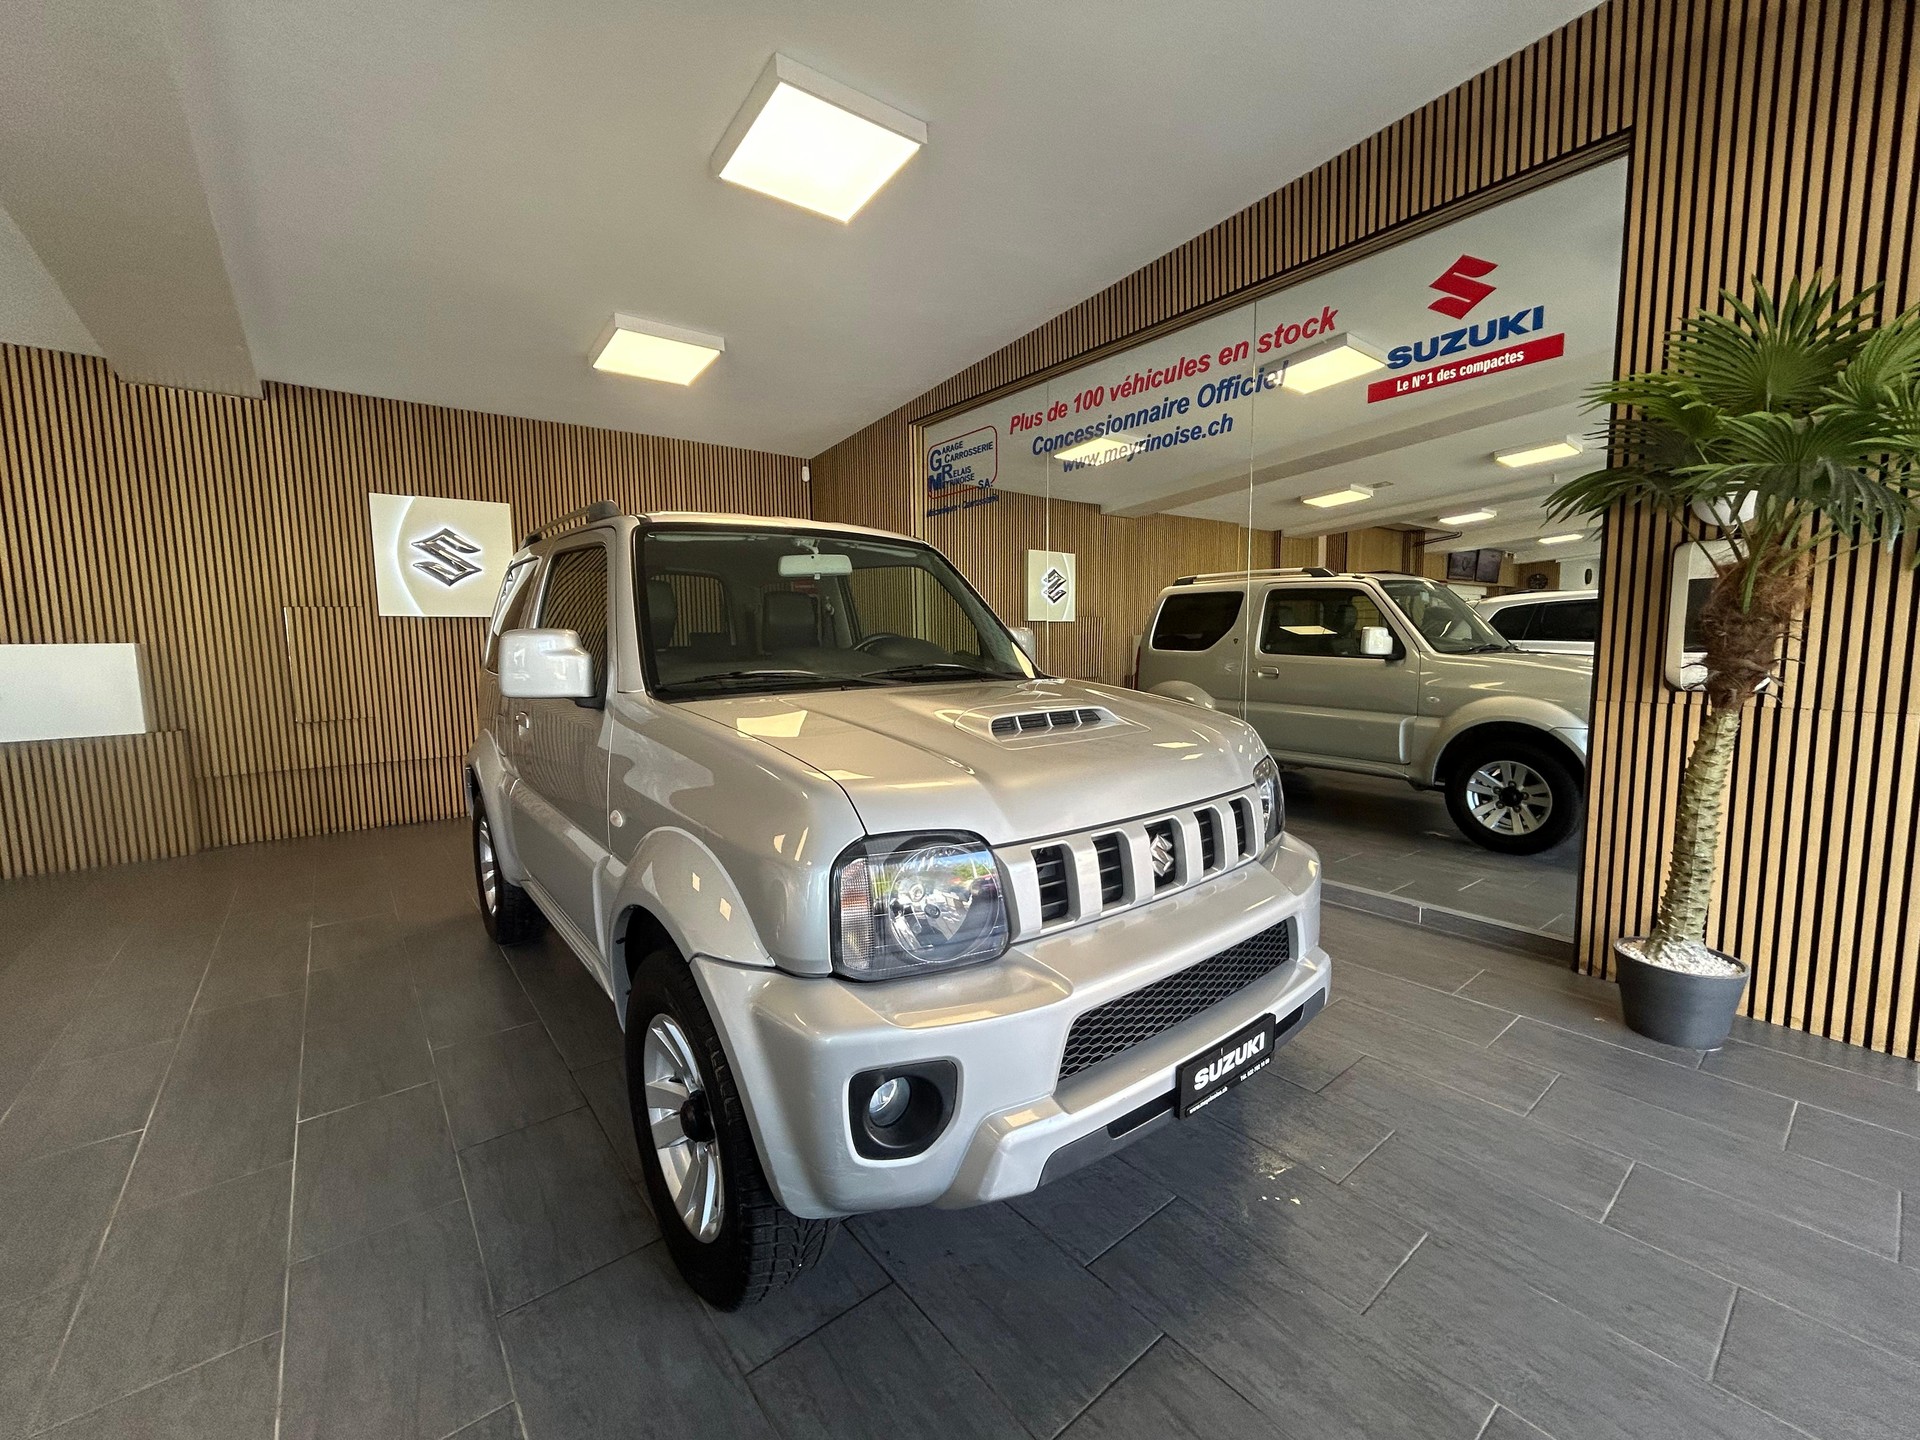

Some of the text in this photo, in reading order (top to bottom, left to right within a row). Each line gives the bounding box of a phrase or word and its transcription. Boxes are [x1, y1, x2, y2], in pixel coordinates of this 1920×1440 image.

[1386, 305, 1545, 370] SUZUKI
[1009, 305, 1339, 435] Plus de 100 véhicules en stock
[1396, 379, 1409, 393] Le
[1436, 366, 1457, 383] des
[1459, 350, 1525, 377] compactes
[1032, 360, 1289, 456] Concessionnaire Officiel
[1062, 413, 1234, 473] www.meyrinoise.ch
[1193, 1031, 1266, 1091] SUZUKI
